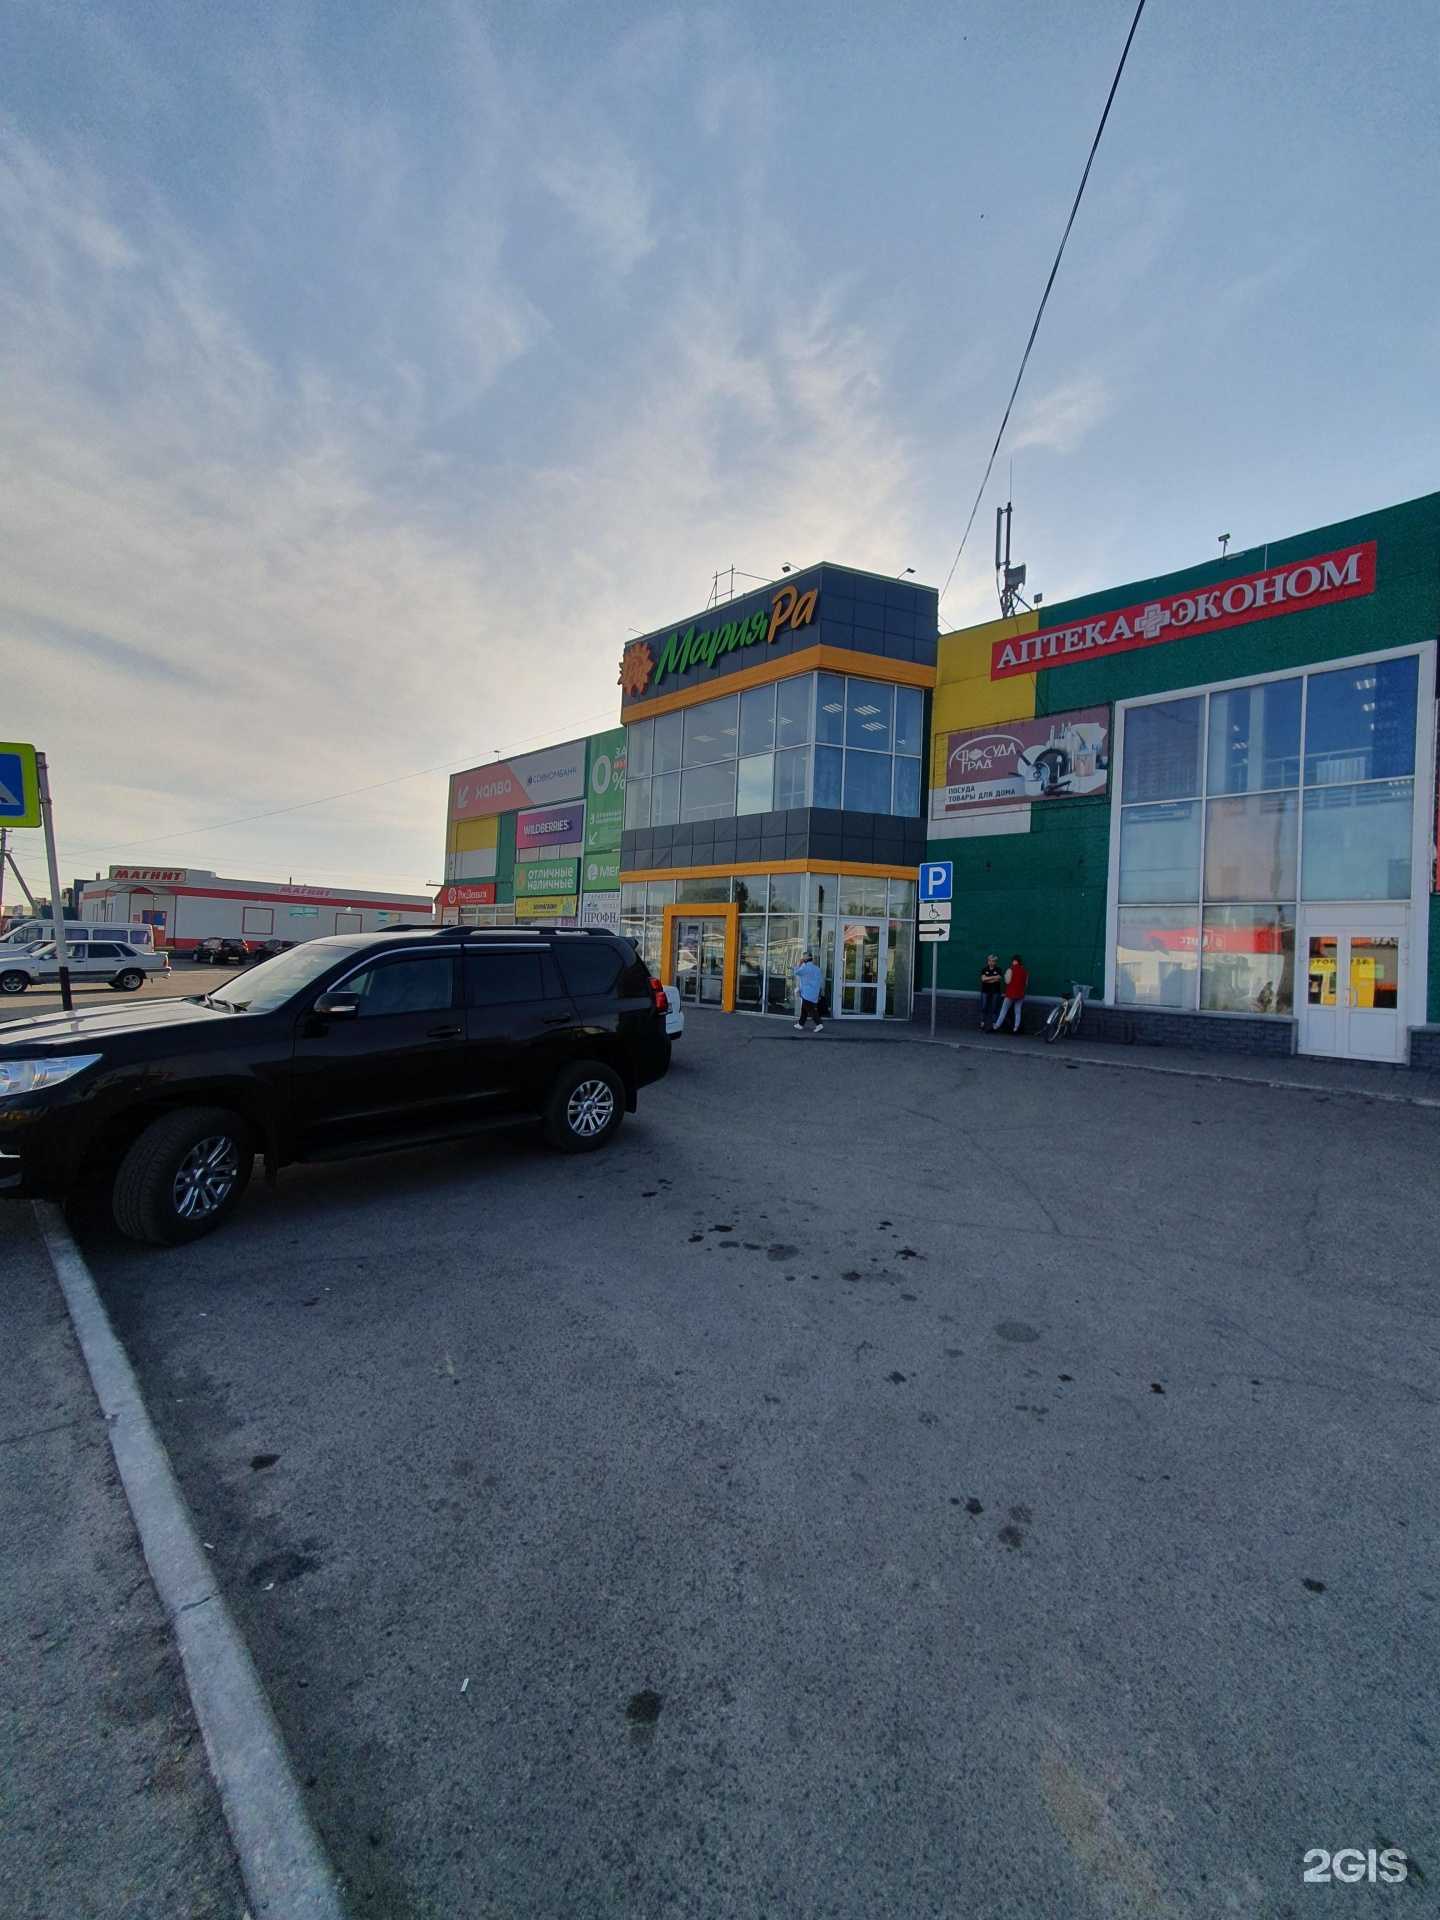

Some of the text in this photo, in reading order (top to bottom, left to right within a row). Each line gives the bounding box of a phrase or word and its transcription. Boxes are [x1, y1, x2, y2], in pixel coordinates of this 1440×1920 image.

[996, 552, 1363, 669] АПТЕКА ЭКОНОМ
[948, 785, 975, 795] ПОСУДА
[948, 788, 1016, 803] ТОВАРЫ ДЛЯ ДОМА
[523, 819, 569, 835] WILDBERRIES
[114, 869, 182, 881] МАГНИТ
[928, 866, 947, 896] P
